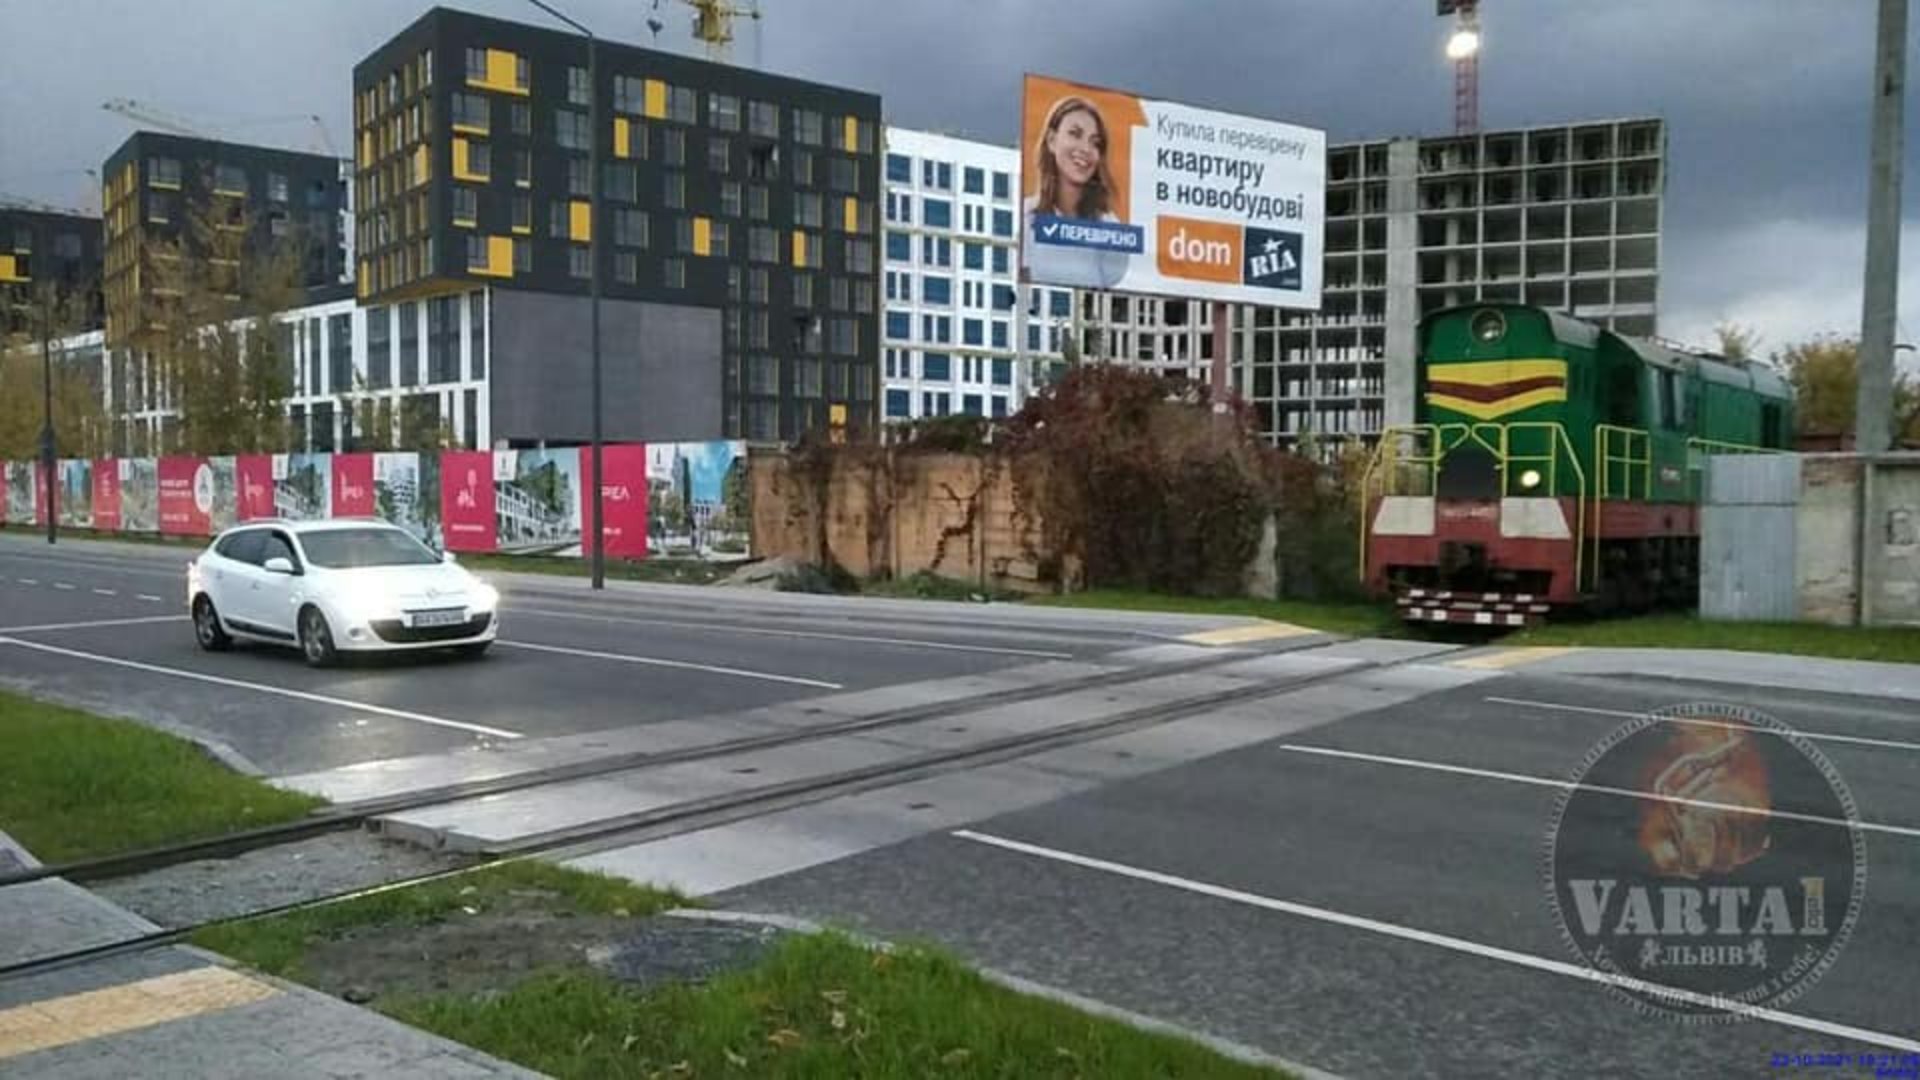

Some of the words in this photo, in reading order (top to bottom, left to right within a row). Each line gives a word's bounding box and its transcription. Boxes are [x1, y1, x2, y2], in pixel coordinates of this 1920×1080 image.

[1157, 112, 1215, 145] Купила
[1221, 126, 1307, 159] перевірену
[1157, 147, 1265, 188] квартиру
[1156, 182, 1169, 202] в
[1177, 183, 1304, 221] новобудові
[1059, 222, 1137, 248] ПЕРЕВІРЕНО
[1169, 229, 1232, 265] dom
[1250, 250, 1297, 280] RIA
